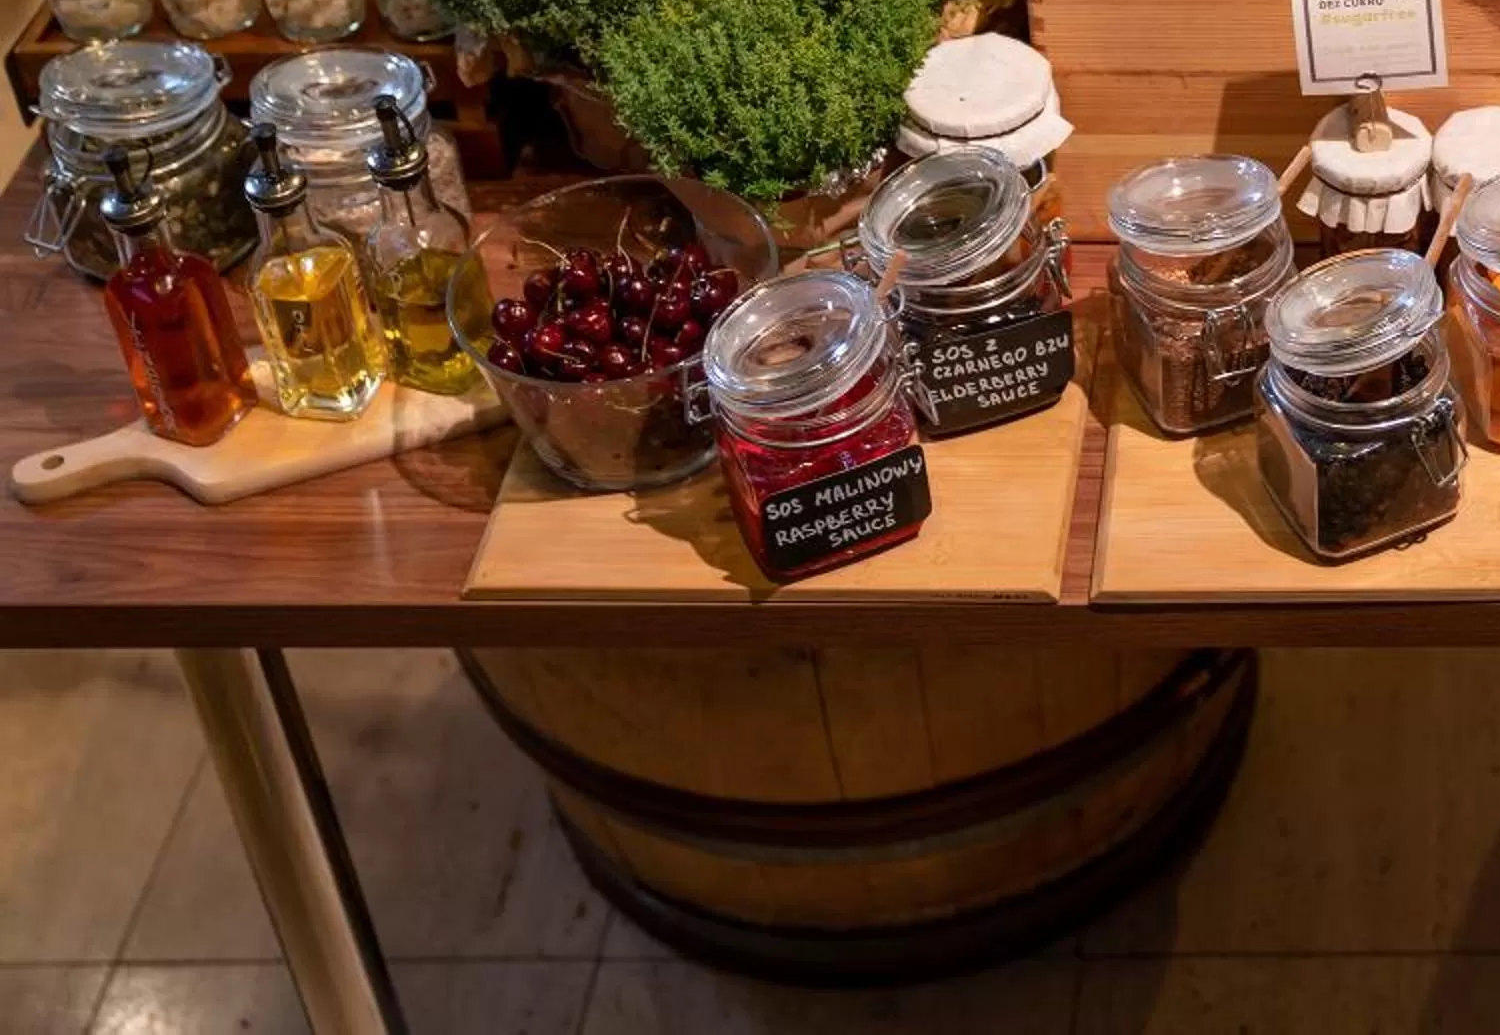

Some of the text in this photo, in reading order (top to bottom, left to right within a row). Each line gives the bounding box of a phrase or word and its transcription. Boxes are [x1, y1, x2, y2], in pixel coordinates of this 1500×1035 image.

[932, 344, 974, 364] SOS
[933, 333, 1069, 380] CZARNEGO BZU
[928, 361, 1049, 404] ELDERBERRY
[977, 381, 1040, 408] SAUCE
[766, 454, 923, 520] SOS MALINOWY
[775, 490, 894, 547] RASPBERRY
[829, 513, 896, 548] SAUCE
